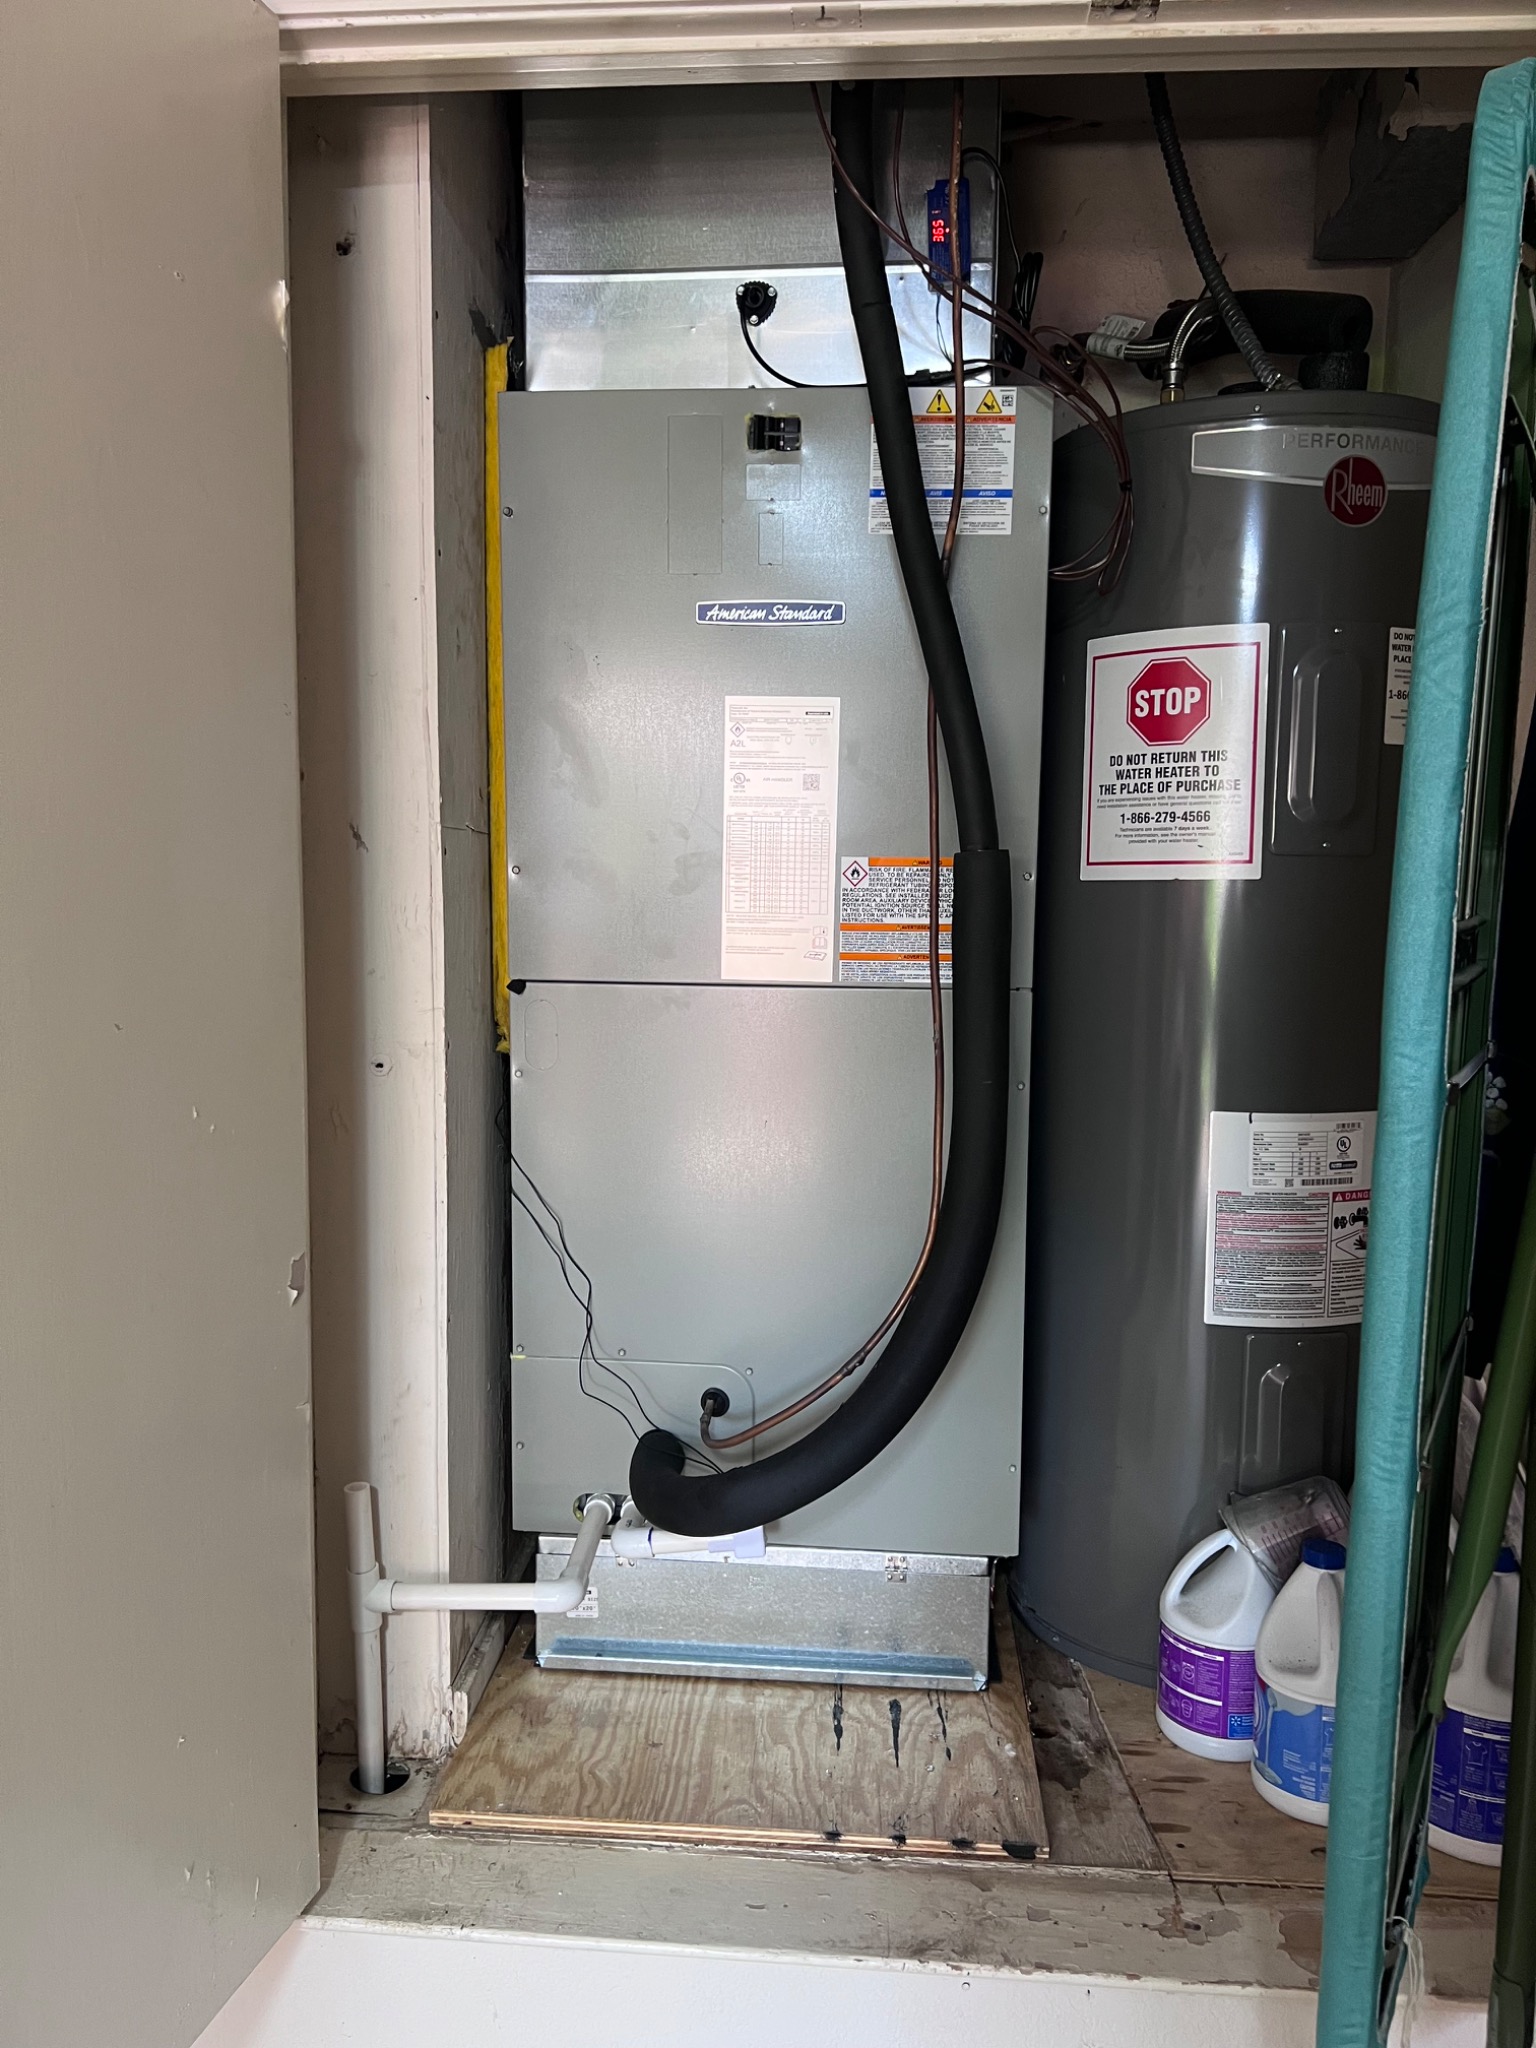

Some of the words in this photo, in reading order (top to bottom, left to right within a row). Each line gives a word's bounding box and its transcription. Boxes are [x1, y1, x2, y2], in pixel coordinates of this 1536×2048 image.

[1331, 457, 1383, 515] Rheem
[705, 604, 766, 621] American
[768, 604, 836, 621] Standard
[1394, 632, 1403, 640] DO
[1392, 644, 1411, 652] WATER
[1393, 655, 1412, 663] PLACE
[1135, 686, 1201, 718] STOP
[1110, 755, 1123, 767] DO
[1126, 753, 1147, 765] NOT
[1150, 751, 1197, 765] RETURN
[1201, 750, 1228, 762] THIS
[1115, 768, 1152, 780] WATER
[1155, 765, 1200, 779] HEATER
[1204, 765, 1219, 777] TO
[1099, 784, 1117, 796] THE
[1120, 782, 1154, 795] PLACE
[1157, 781, 1172, 793] OF
[1176, 779, 1241, 792] PURCHASE
[1120, 810, 1211, 824] 1-866-279-4566
[1340, 1139, 1348, 1149] UL
[1345, 1191, 1369, 1200] DANG
